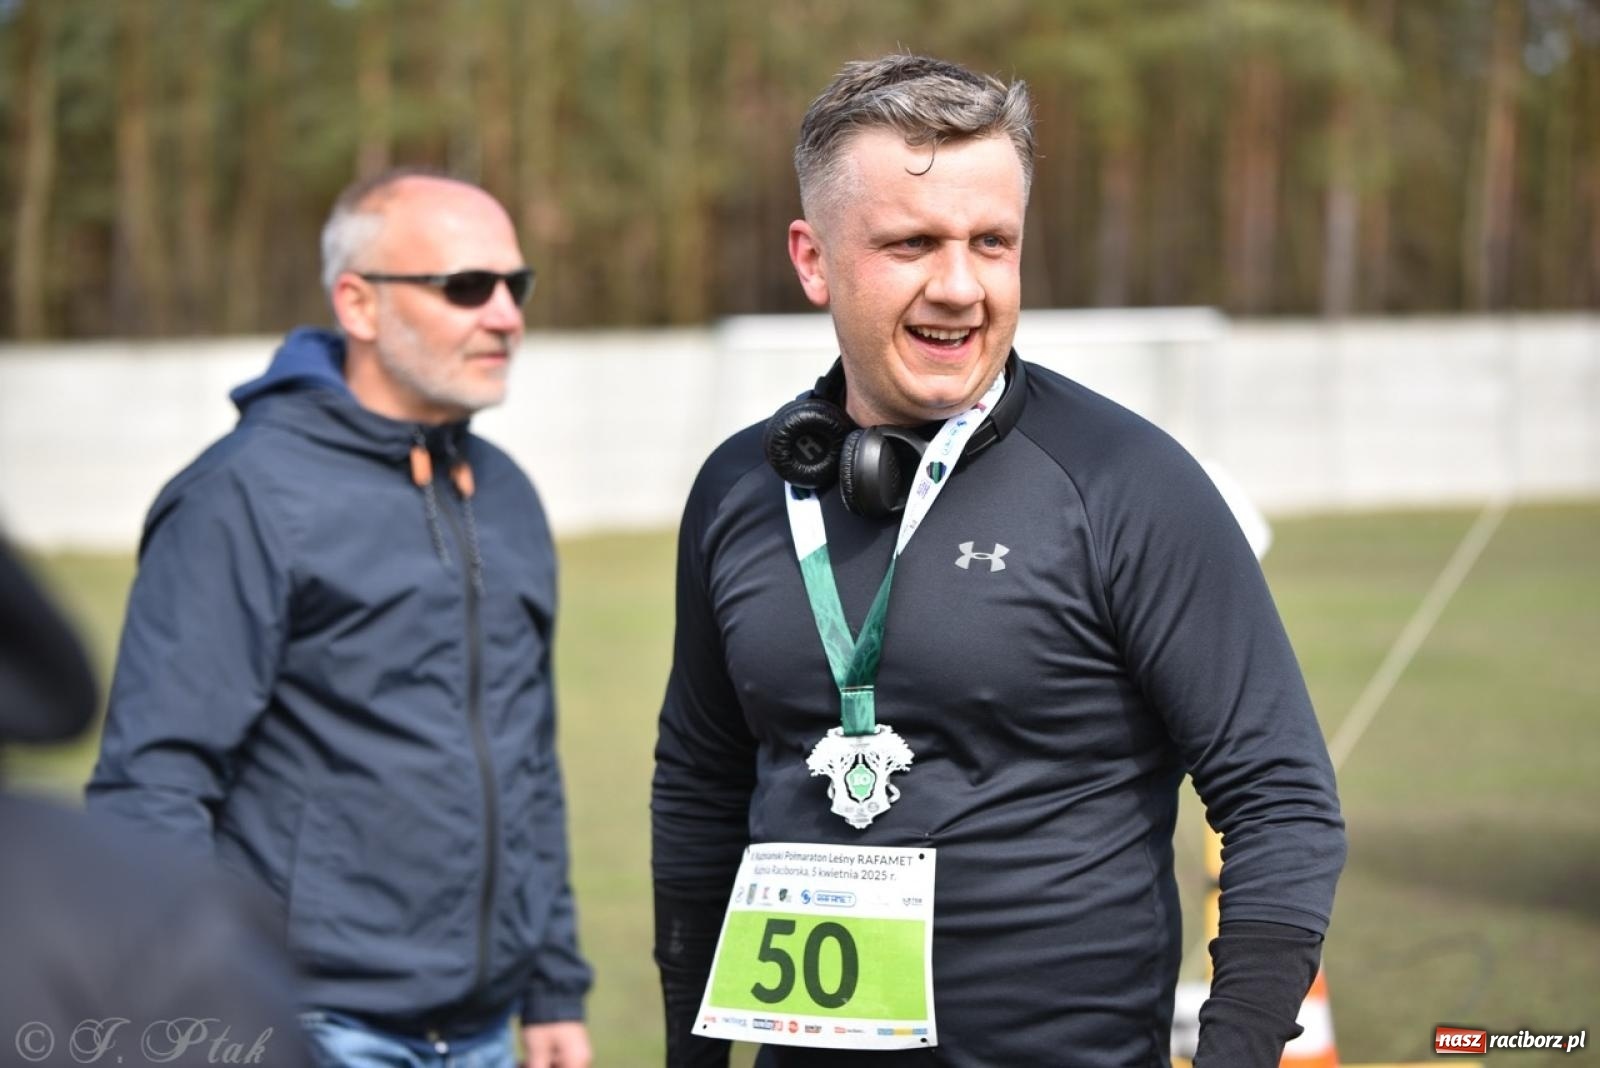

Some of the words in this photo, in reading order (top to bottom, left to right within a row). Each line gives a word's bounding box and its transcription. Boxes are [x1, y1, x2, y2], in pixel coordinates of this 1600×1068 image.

[828, 852, 856, 866] Leśny
[857, 854, 914, 867] RAFAMET
[818, 867, 859, 880] kwietnia
[860, 869, 888, 881] 2025
[889, 872, 897, 881] r.
[750, 918, 859, 1009] 50
